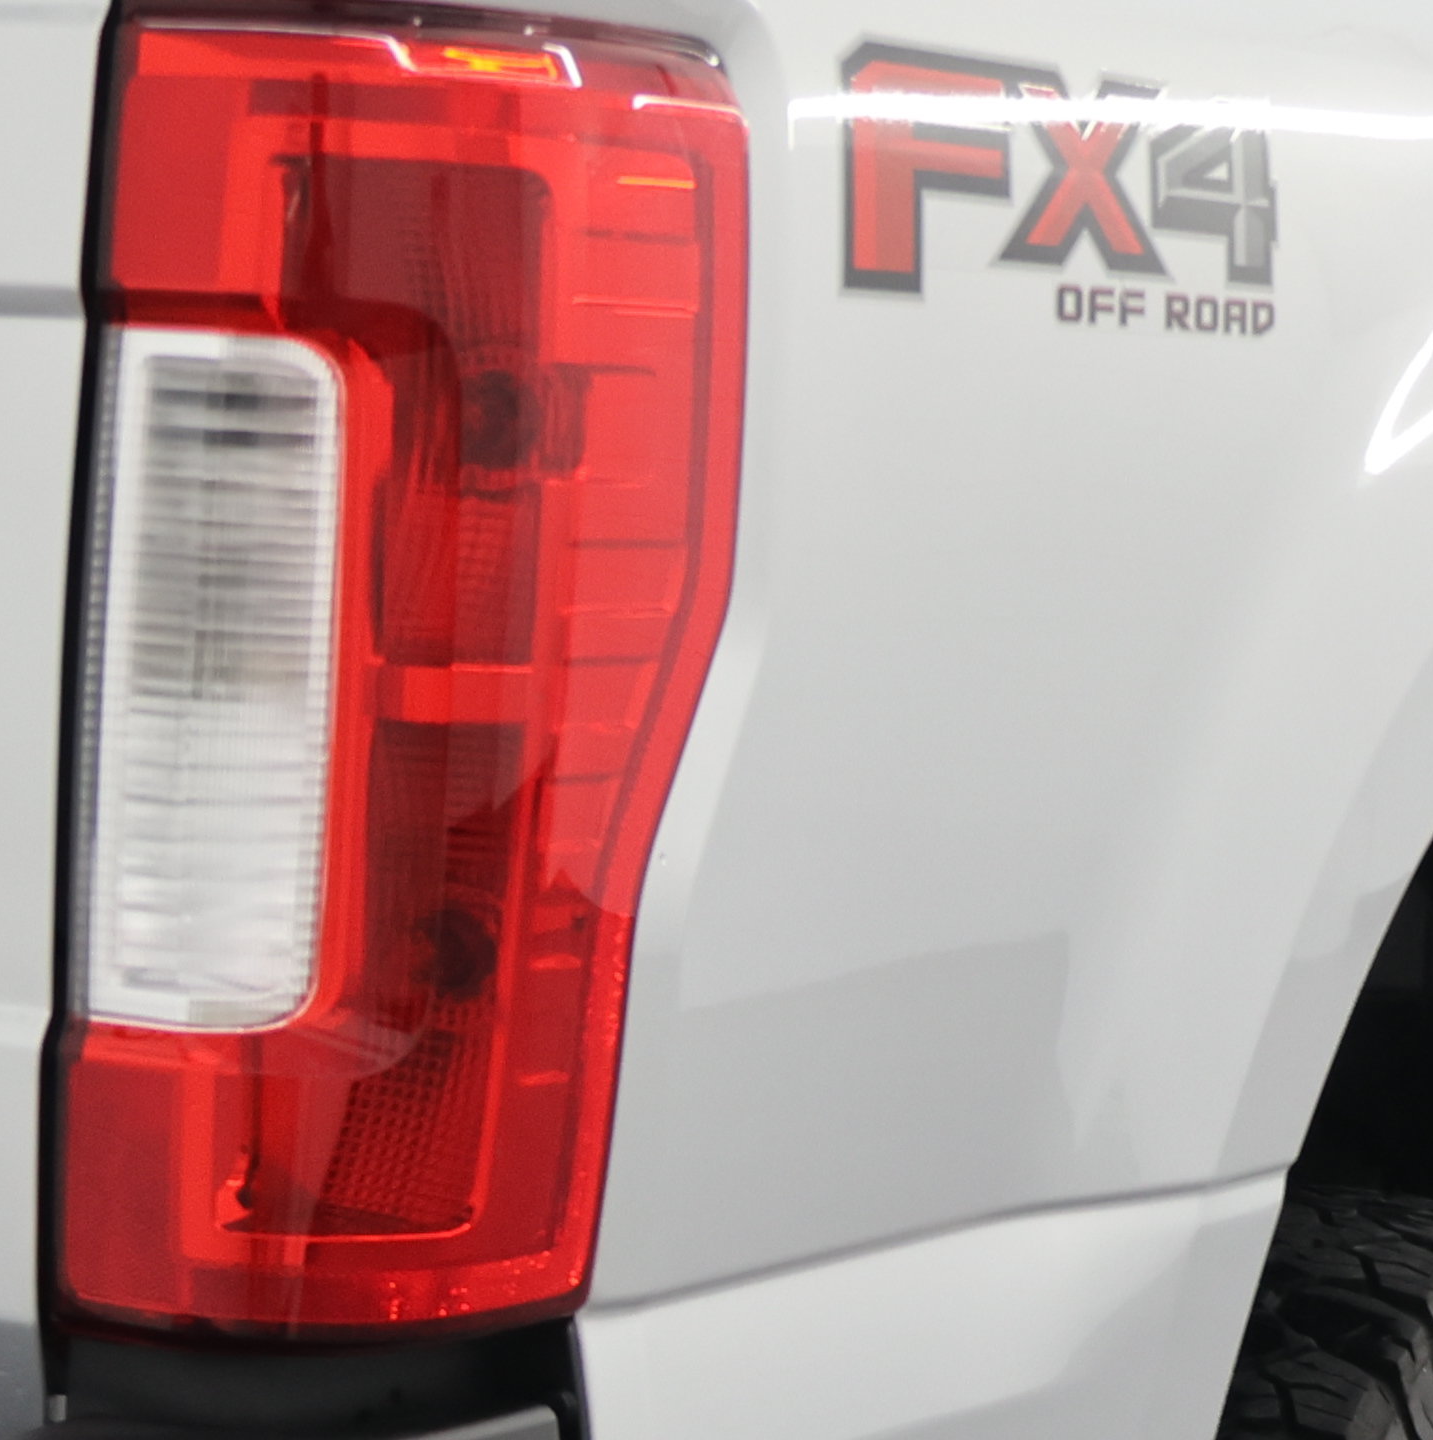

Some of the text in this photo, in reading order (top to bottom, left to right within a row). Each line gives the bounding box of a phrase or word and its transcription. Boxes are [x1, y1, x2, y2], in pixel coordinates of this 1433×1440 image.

[836, 34, 1277, 300] FX4
[1054, 283, 1275, 337] OFF ROAD
